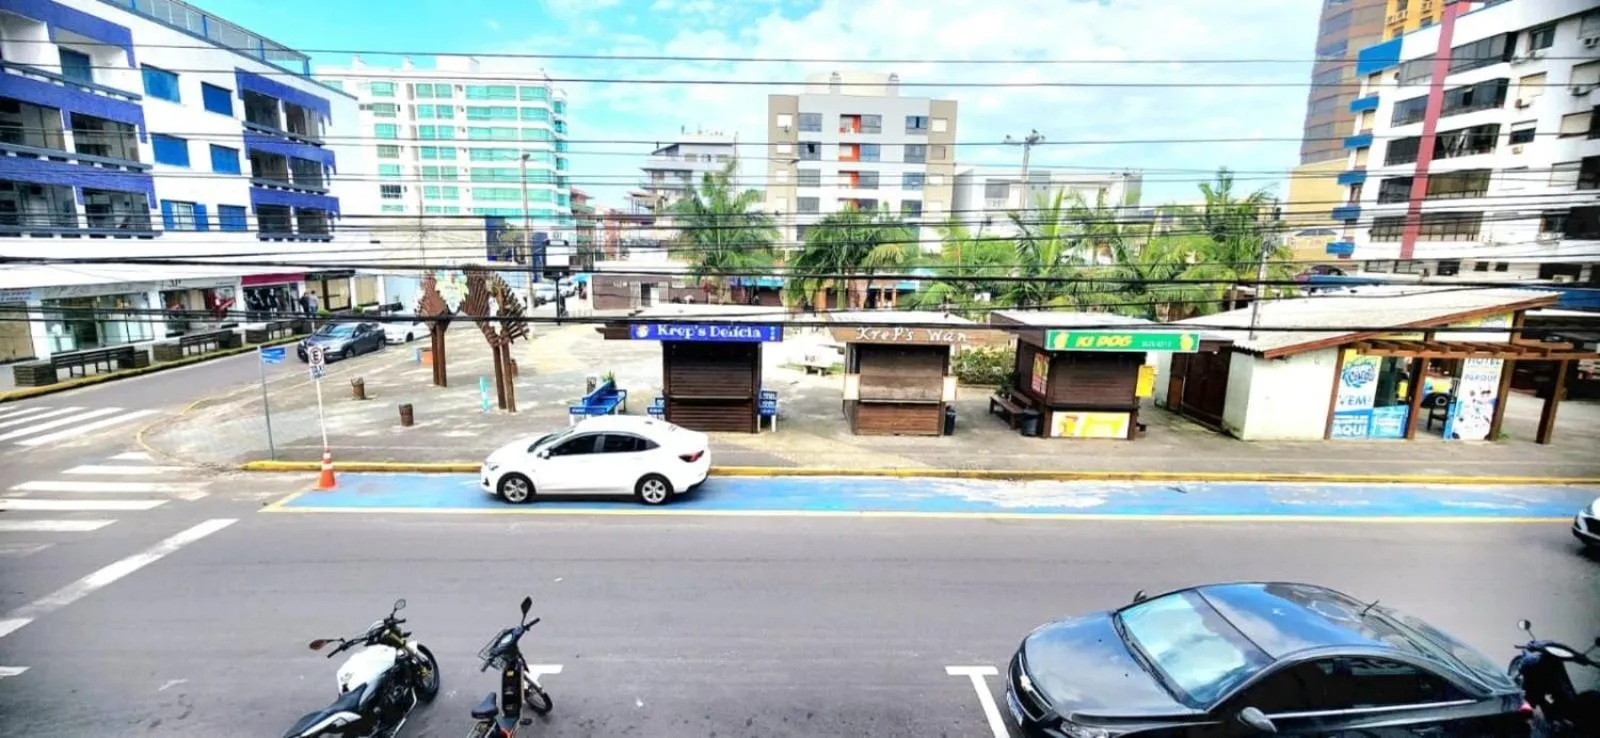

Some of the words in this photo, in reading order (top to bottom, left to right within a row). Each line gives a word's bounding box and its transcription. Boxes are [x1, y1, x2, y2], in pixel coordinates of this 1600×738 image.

[657, 324, 706, 339] Krep's
[928, 329, 968, 342] Wan
[1095, 335, 1133, 347] DOG
[313, 350, 319, 361] E
